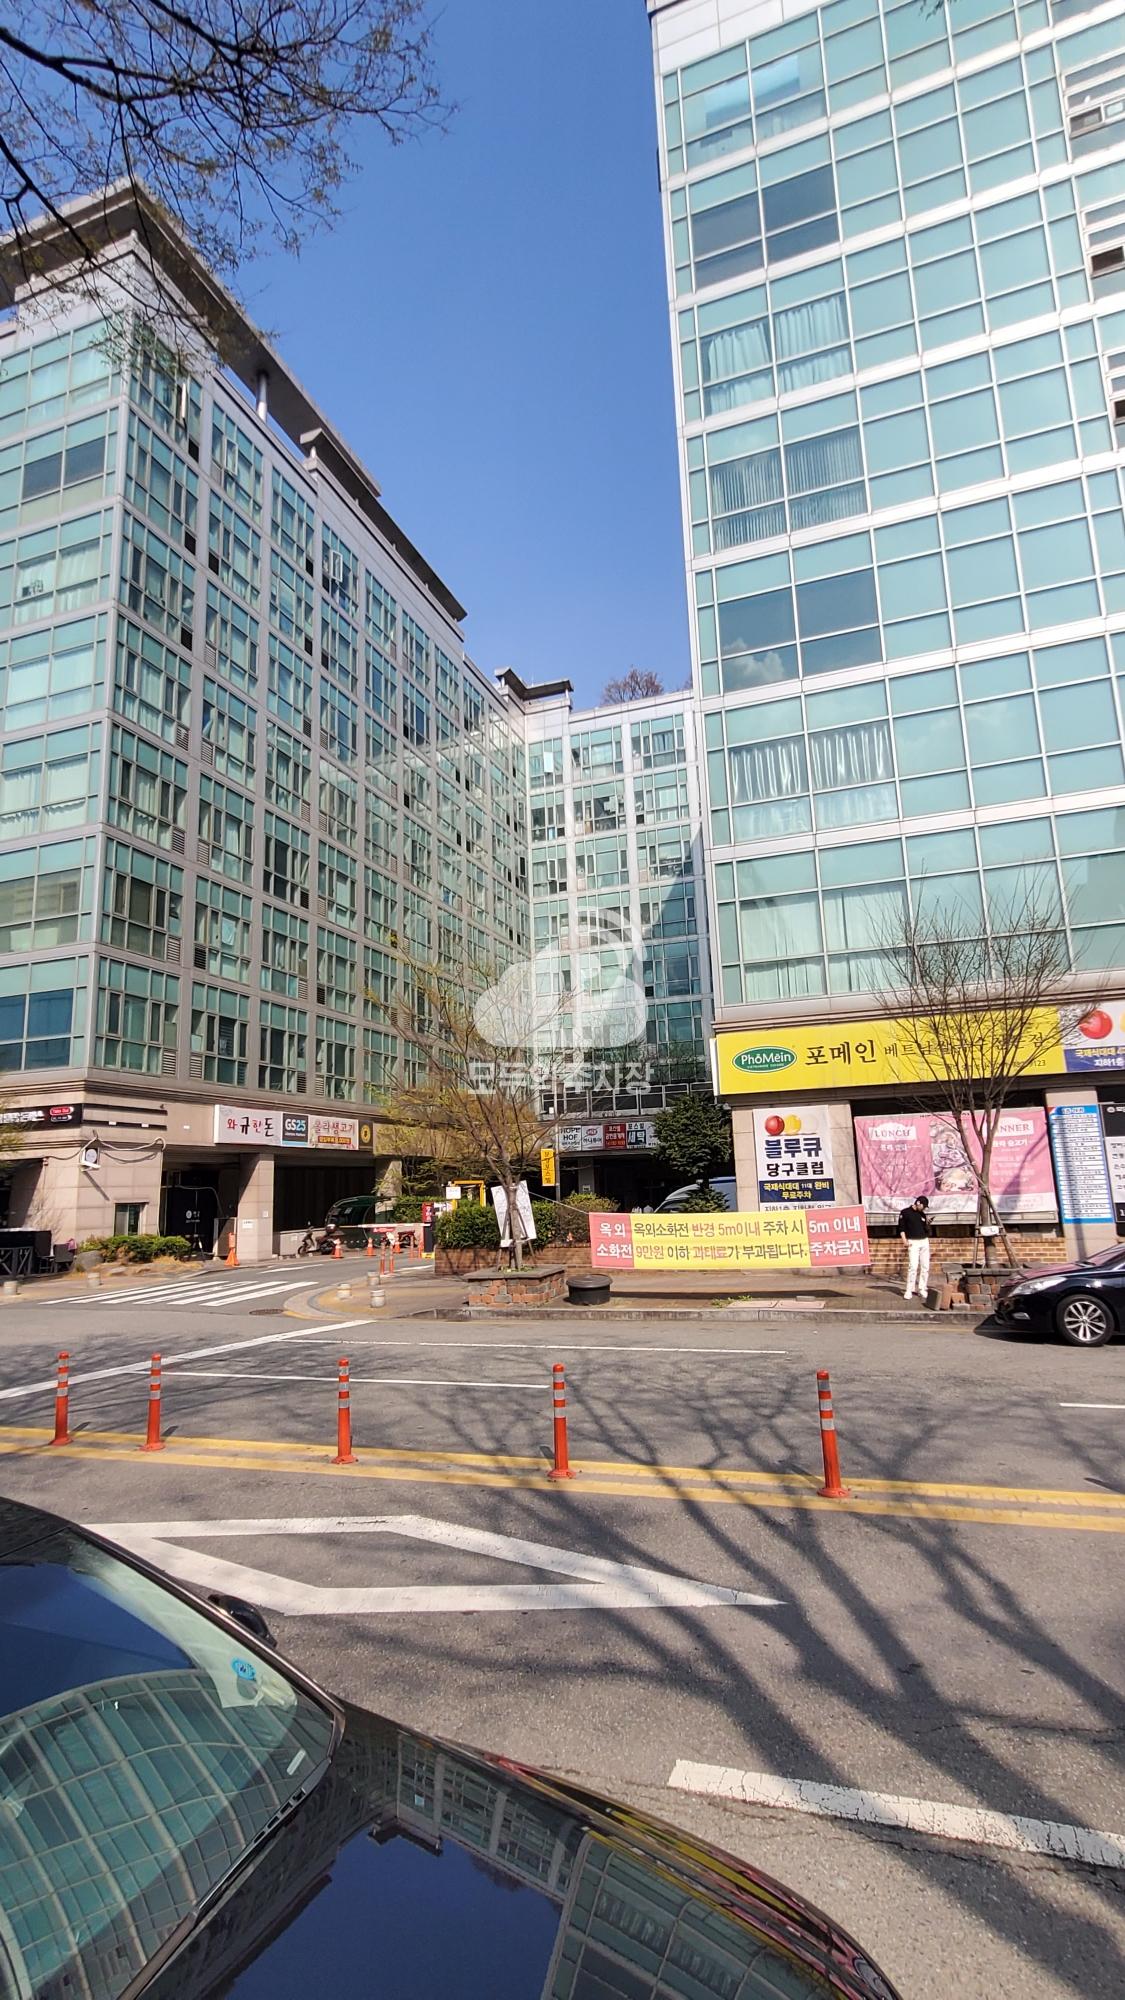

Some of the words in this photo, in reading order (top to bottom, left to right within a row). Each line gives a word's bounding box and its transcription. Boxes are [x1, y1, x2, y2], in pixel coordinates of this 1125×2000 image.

[804, 1040, 877, 1066] 포메인
[285, 1118, 306, 1132] GS25
[764, 1137, 822, 1159] 블루큐
[766, 1161, 824, 1177] 당구클럽
[782, 1190, 812, 1199] 무료주차
[634, 1222, 689, 1238] 옥외소화전
[692, 1222, 715, 1238] 반경
[718, 1220, 760, 1237] 5m이내
[763, 1220, 788, 1236] 주차
[791, 1219, 804, 1234] 시
[809, 1220, 829, 1234] 5m
[833, 1216, 860, 1233] 이내
[597, 1243, 633, 1258] 소화전
[635, 1245, 664, 1259] 9만원
[667, 1245, 690, 1260] 이하
[693, 1244, 740, 1260] 과태료가
[743, 1243, 808, 1260] 부과됩니다.
[810, 1238, 865, 1257] 주차금지
